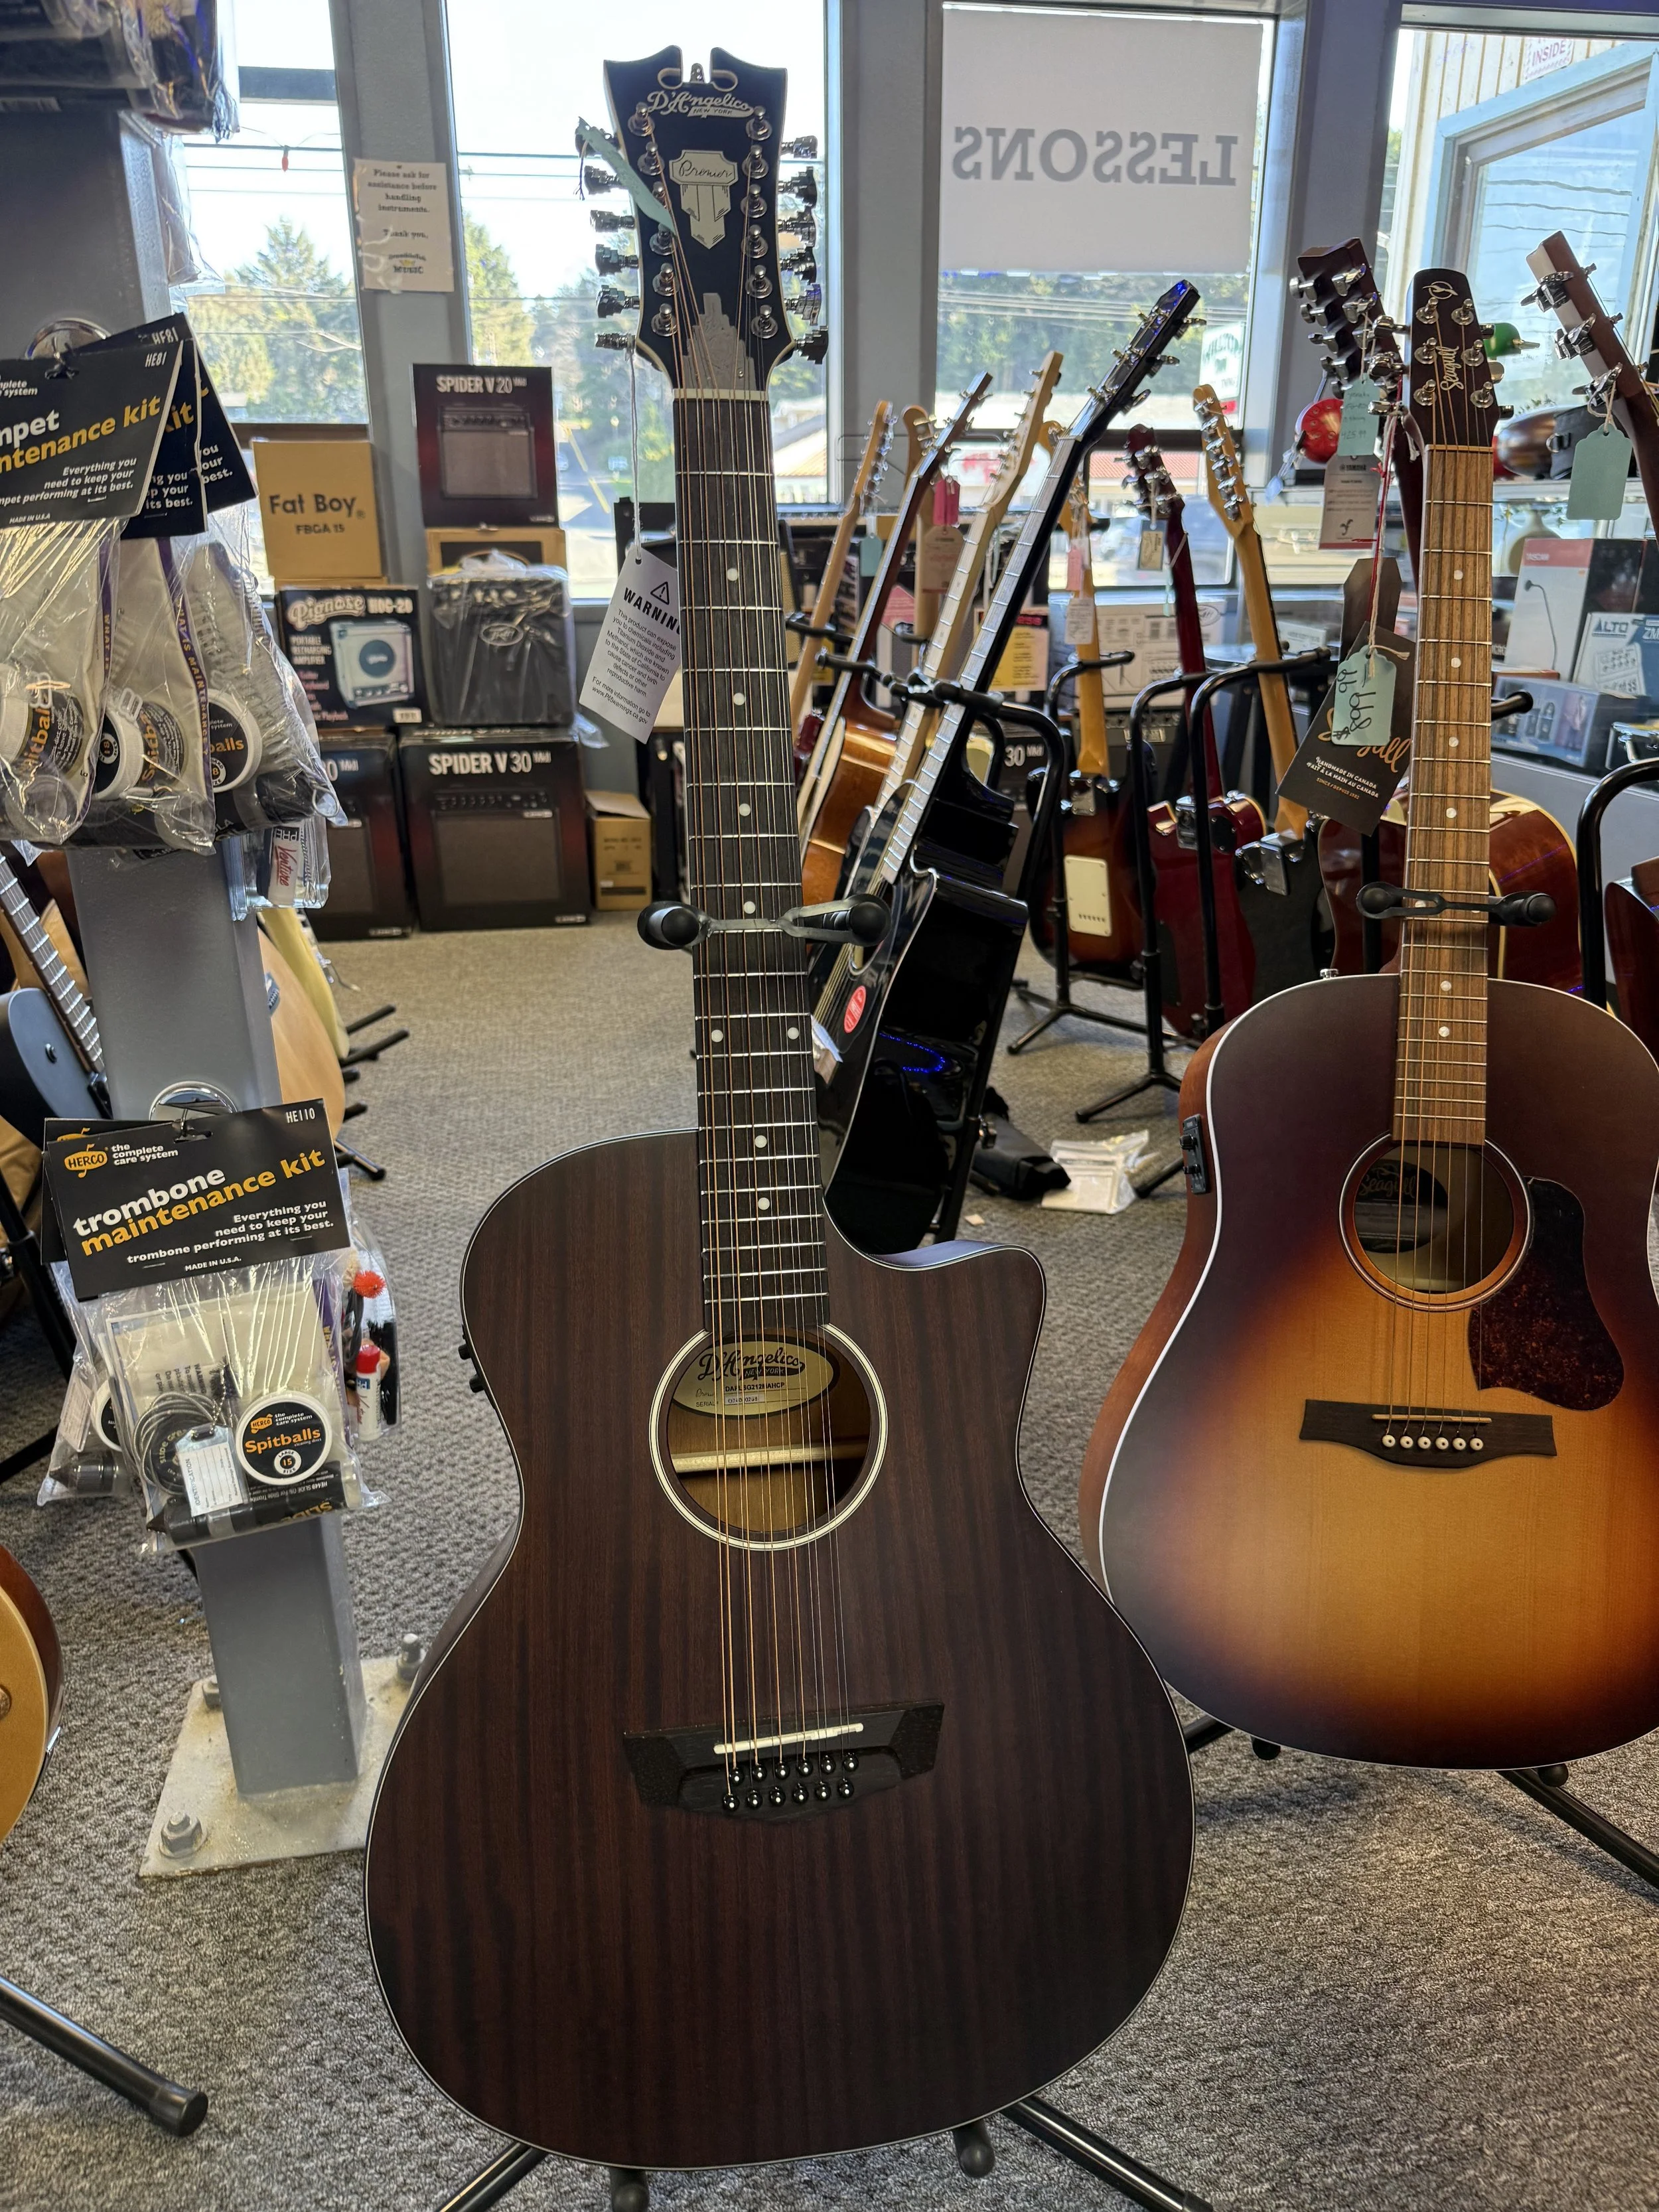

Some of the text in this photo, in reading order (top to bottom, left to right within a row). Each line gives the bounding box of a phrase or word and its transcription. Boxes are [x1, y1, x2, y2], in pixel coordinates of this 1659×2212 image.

[1532, 40, 1566, 67] INSIDE
[647, 90, 755, 115] D'Angelico
[374, 169, 400, 178] Please
[368, 181, 409, 190] assistance
[385, 193, 421, 203] handling
[145, 352, 167, 368] HE81
[1439, 346, 1465, 391] Seagull
[4, 388, 38, 398] system
[437, 375, 513, 394] SPIDER V 20
[123, 396, 161, 428] kit
[200, 444, 219, 457] ou
[63, 457, 137, 477] Everything you
[201, 456, 224, 471] our
[44, 480, 68, 490] need
[84, 474, 108, 486] keep
[111, 470, 134, 481] your
[167, 472, 188, 484] you
[23, 489, 79, 504] performing
[95, 486, 108, 495] its
[162, 485, 189, 498] your
[269, 493, 357, 517] Fat Boy
[295, 524, 332, 535] FBGA
[623, 587, 681, 635] WARNIN
[613, 617, 622, 626] you
[628, 627, 652, 645] chemicals
[652, 642, 676, 660] including
[618, 609, 677, 651] This product can expose
[617, 627, 636, 644] Titanium
[636, 640, 654, 656] Dioxide
[607, 650, 658, 686] cause cancer and birth
[611, 642, 620, 652] the
[619, 647, 631, 660] State
[637, 659, 660, 678] California
[630, 646, 644, 659] which
[653, 660, 670, 675] known
[607, 668, 634, 689] reproductive
[613, 662, 628, 677] defects
[634, 678, 648, 688] other
[593, 676, 602, 686] For
[602, 683, 614, 693] more
[614, 690, 638, 710] information
[429, 750, 532, 775] SPIDER V 30
[1004, 744, 1026, 767] 30
[1315, 755, 1347, 775] HANDMADE
[1354, 774, 1378, 790] CANADA
[1333, 773, 1348, 784] MAIN
[1356, 784, 1379, 798] CANADA
[286, 1108, 316, 1124] HE110
[111, 1143, 131, 1152] the
[112, 1145, 164, 1159] complete
[113, 1149, 179, 1166] care system
[68, 1153, 105, 1168] HERCO
[72, 1168, 226, 1238] trombone
[81, 1148, 326, 1257] maintenance kit
[234, 1201, 326, 1224] Everything you
[214, 1211, 328, 1238] need to keep your
[126, 1220, 334, 1264] trombone performing at its best.
[184, 1263, 208, 1272] MADE
[220, 1256, 242, 1265] U.S.A.
[697, 1347, 806, 1382] D'Angelico
[765, 1367, 784, 1376] YORK
[252, 1419, 271, 1428] HERCO
[275, 1412, 304, 1422] complete
[291, 1414, 313, 1424] system
[245, 1428, 321, 1455] Spitballs
